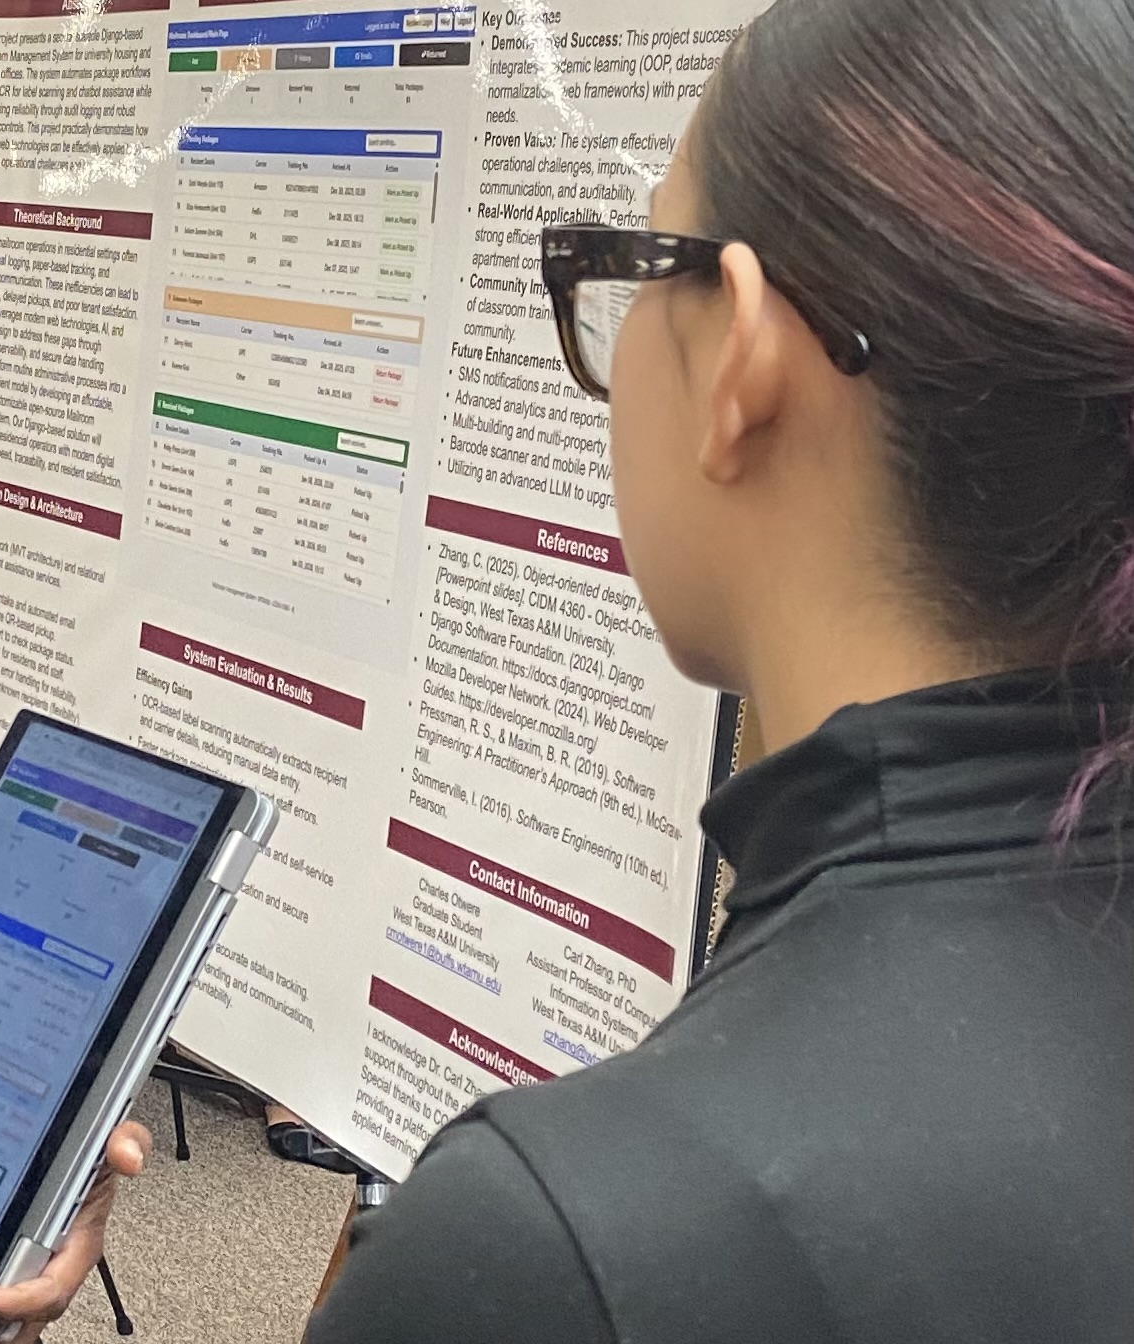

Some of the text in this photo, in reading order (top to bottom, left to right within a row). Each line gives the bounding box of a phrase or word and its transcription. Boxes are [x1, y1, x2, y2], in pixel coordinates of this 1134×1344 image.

[482, 10, 503, 30] Key
[571, 28, 690, 50] Success: This project
[484, 131, 676, 155] Proven The system effectively
[480, 181, 555, 199] communication,
[557, 182, 578, 199] and
[14, 207, 103, 231] Theoretical Background
[477, 202, 534, 220] Real-World
[470, 273, 527, 297] Community
[452, 341, 483, 360] Future
[459, 365, 560, 396] SMS notifications and
[455, 389, 568, 422] Advanced analytics and
[452, 412, 607, 458] Multi-building and multi-property
[450, 434, 586, 476] Barcode scanner and mobile
[448, 458, 585, 501] Utilizing an advanced LLM to
[4, 488, 29, 509] Design
[30, 495, 36, 510] &
[37, 498, 84, 523] Architecture
[537, 528, 609, 562] References
[439, 543, 636, 611] Zhang, C. (2025). Object-oriented design
[428, 633, 499, 669] Documentation.
[431, 610, 645, 692] Django Software Foundation. (2024). Django
[136, 667, 193, 700] Efficiency Gains
[184, 643, 313, 704] System Evaluation & Results
[423, 678, 457, 703] Guides.
[426, 655, 669, 751] Mozilla Developer Network. (2024). Web Developer
[182, 709, 200, 727] label
[200, 719, 232, 744] scanning
[282, 753, 313, 774] extracts
[313, 766, 348, 789] recipient
[409, 789, 448, 818] Pearson.
[419, 877, 449, 903] Charles
[470, 860, 589, 928] Contact Information
[413, 895, 483, 940] Graduate Student
[394, 905, 500, 973] West Texas A&M University
[564, 945, 637, 993] Carl Zhang, PhD
[361, 1064, 432, 1119] Special thanks to
[365, 1045, 460, 1112] support throughout the
